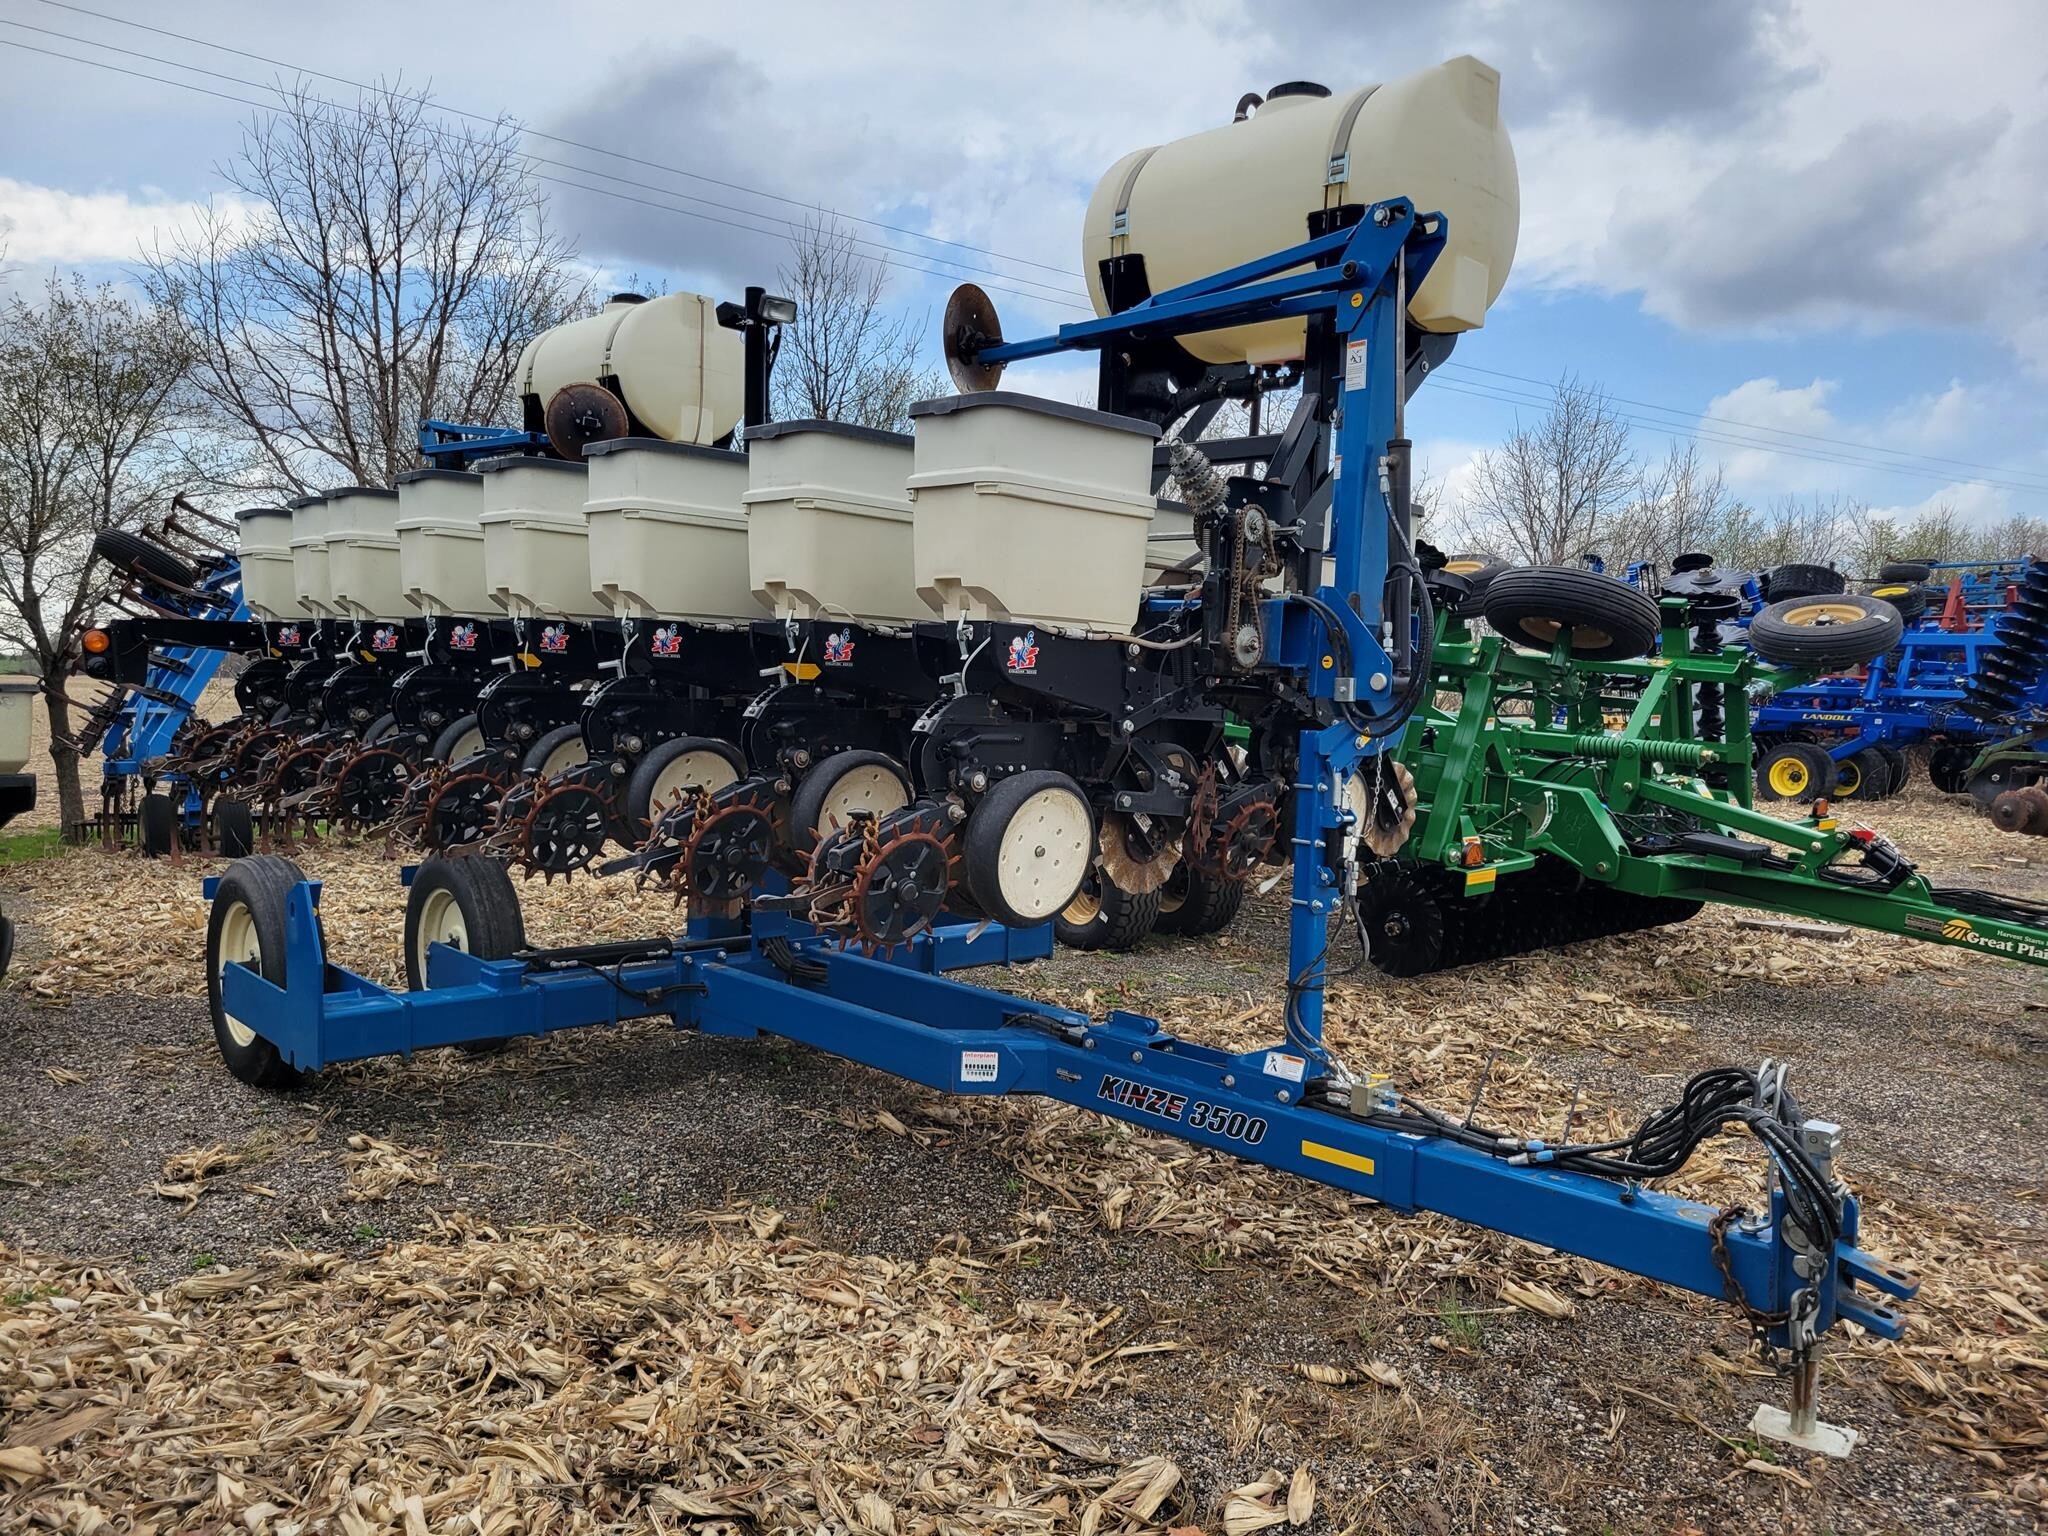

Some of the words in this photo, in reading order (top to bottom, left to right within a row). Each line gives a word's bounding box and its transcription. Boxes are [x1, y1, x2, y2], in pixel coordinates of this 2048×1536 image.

[1802, 713, 1853, 721] LANDOLL
[1966, 932, 2014, 952] Great
[1097, 1074, 1188, 1121] KINZE
[1189, 1101, 1268, 1145] 3500
